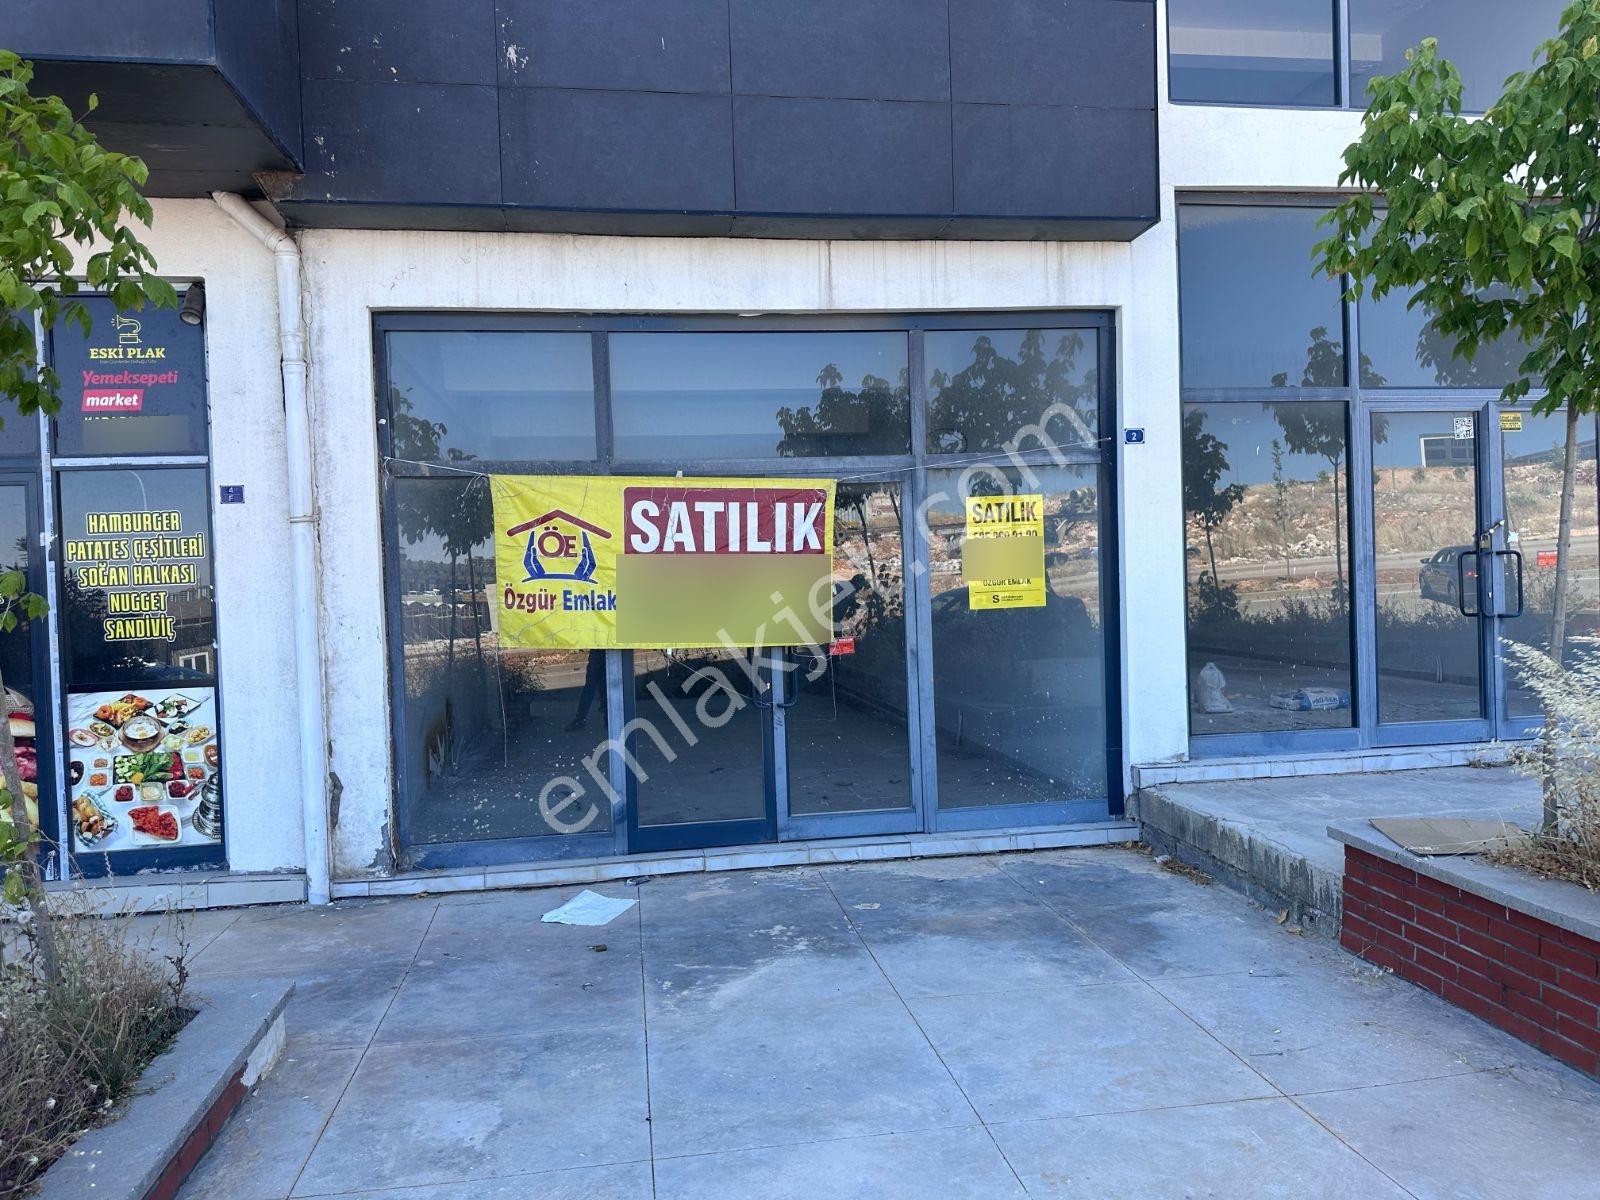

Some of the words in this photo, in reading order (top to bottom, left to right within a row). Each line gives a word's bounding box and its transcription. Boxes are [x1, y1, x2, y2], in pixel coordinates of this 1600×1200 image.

[89, 345, 123, 359] ESKİ
[126, 348, 166, 359] PLAK
[82, 370, 178, 386] Yemeksepeti
[86, 393, 139, 406] market
[1131, 432, 1137, 440] 2
[87, 511, 182, 534] HAMBURGER
[972, 501, 1038, 523] SATILIK
[630, 500, 823, 554] SATILIK
[66, 540, 130, 562] PATATES
[132, 533, 205, 564] ÇEŞİTLERİ
[537, 526, 578, 558] ÖE
[78, 562, 130, 589] SOĞAN
[132, 564, 197, 587] HALKASI
[108, 591, 167, 613] NUGGET
[504, 584, 557, 613] Özgür
[562, 589, 617, 611] Emlak
[104, 614, 176, 642] SANDİVİÇ
